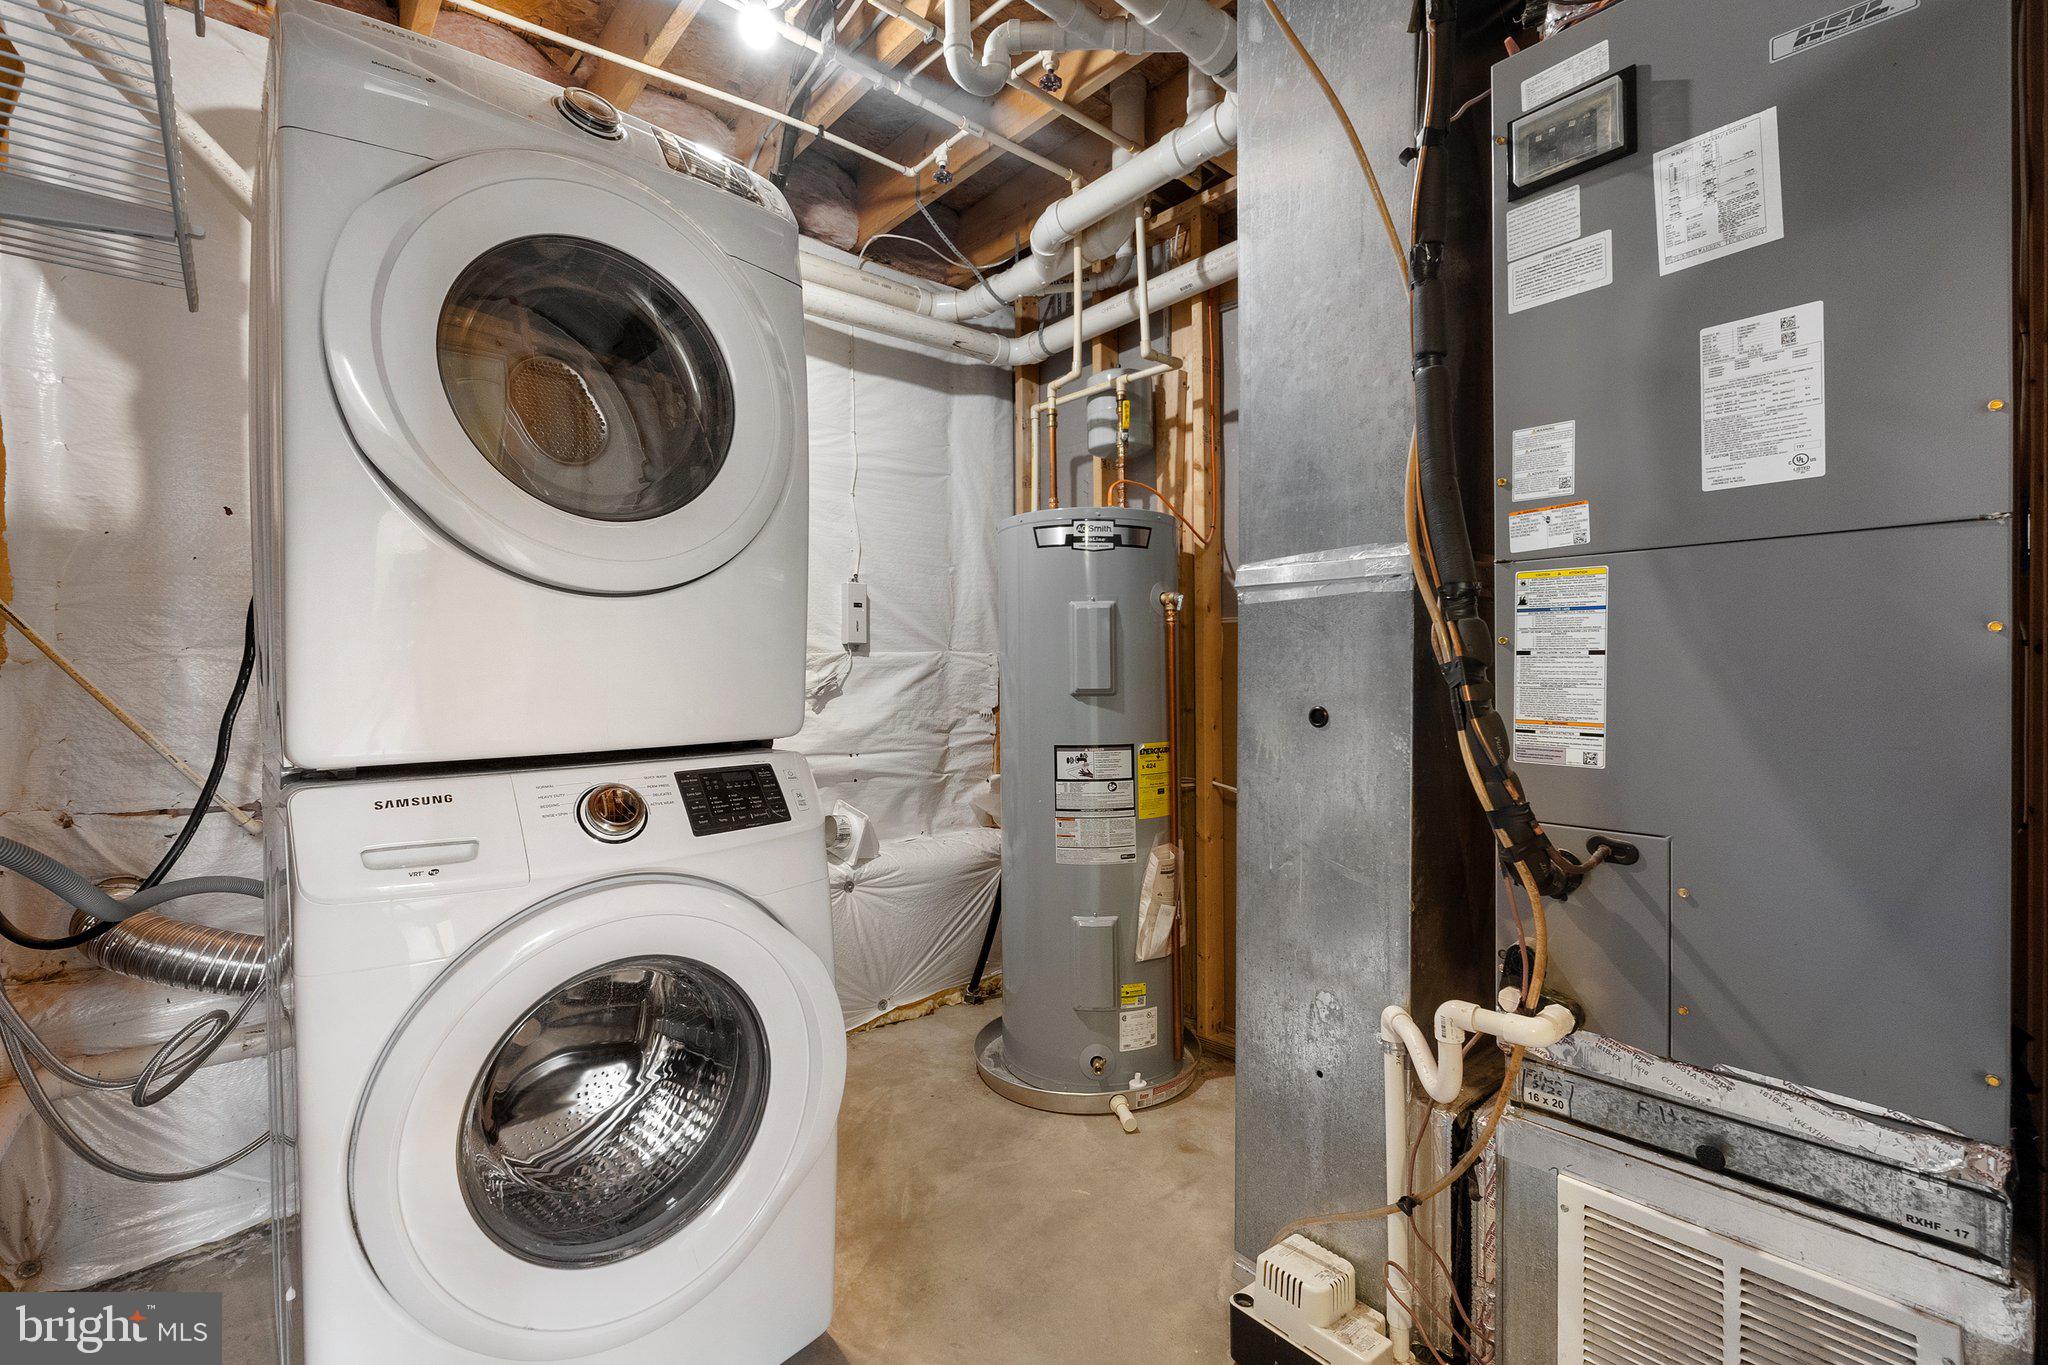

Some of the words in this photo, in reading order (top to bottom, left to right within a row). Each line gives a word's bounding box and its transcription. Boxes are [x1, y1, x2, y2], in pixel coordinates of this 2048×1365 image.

[1089, 525, 1112, 533] Smith
[374, 794, 453, 811] SAMSUNG
[1528, 1091, 1540, 1102] 16
[1542, 1096, 1549, 1105] x
[1552, 1098, 1564, 1110] 20
[1905, 1213, 1941, 1231] RXHF
[1954, 1228, 1970, 1239] 17
